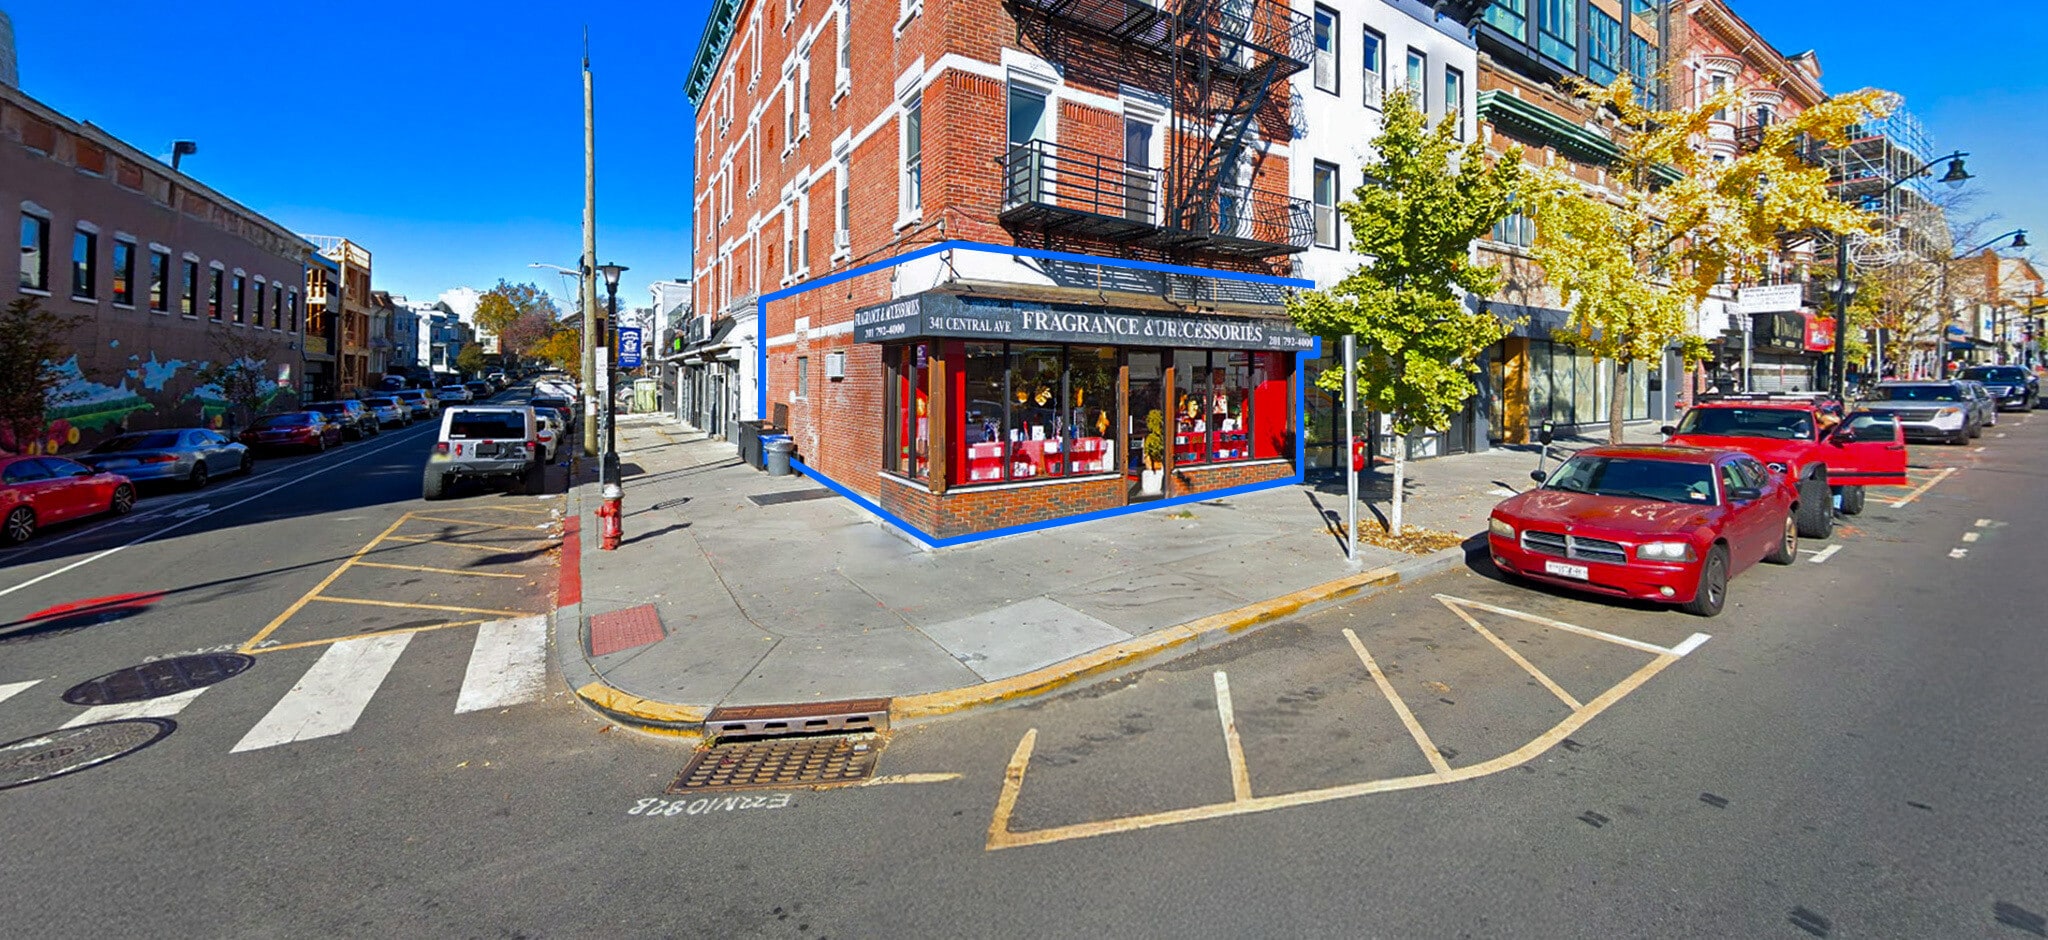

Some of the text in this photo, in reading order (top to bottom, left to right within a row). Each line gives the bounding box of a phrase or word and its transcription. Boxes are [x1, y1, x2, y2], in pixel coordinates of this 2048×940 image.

[928, 316, 1012, 333] 341 CENTRAL AVE
[1021, 311, 1139, 335] FRAGRANCE
[1143, 318, 1154, 336] &
[1268, 335, 1314, 348] 201 792-4000
